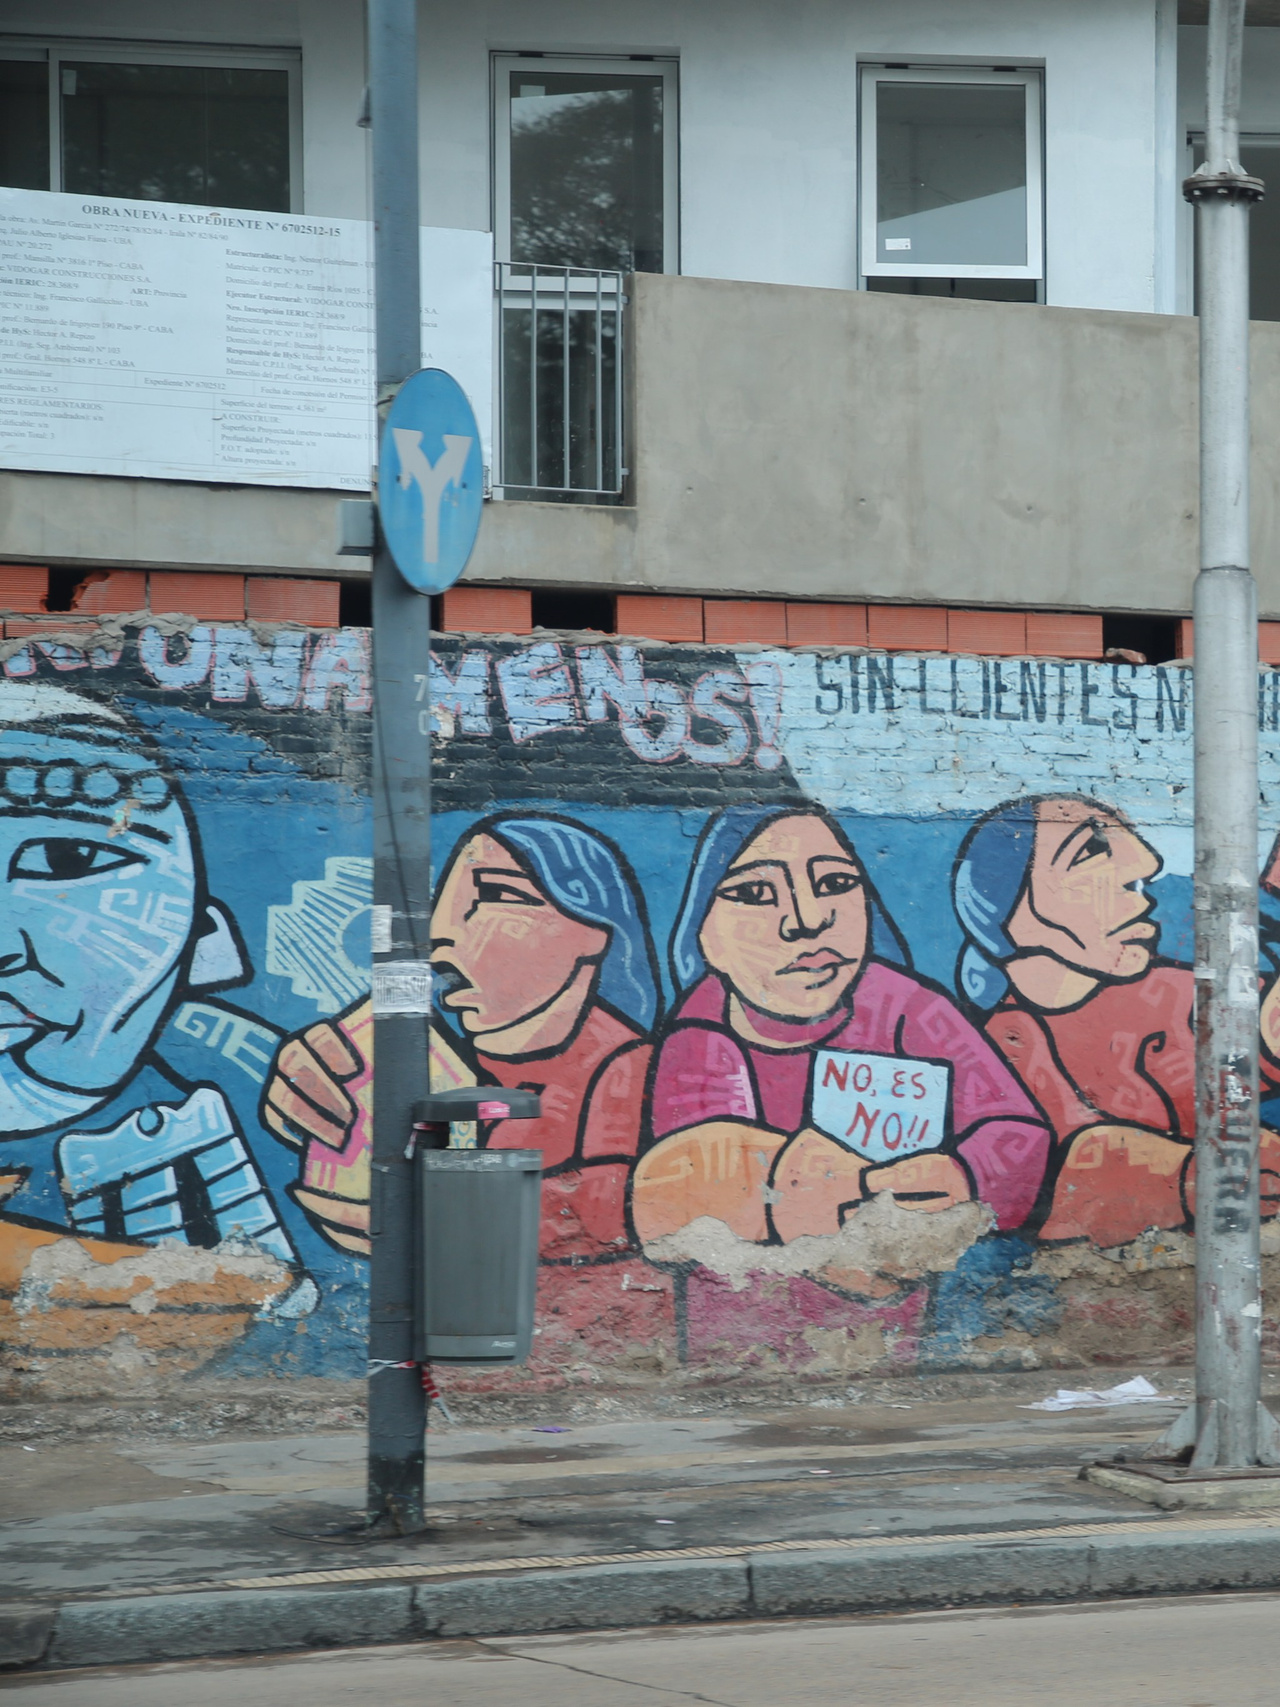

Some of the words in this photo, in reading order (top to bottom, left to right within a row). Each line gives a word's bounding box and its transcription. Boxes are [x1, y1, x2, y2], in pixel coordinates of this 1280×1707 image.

[82, 204, 120, 216] OBRA
[123, 208, 168, 220] NUEVA
[179, 213, 262, 229] EXPEDIENTE
[282, 222, 340, 236] 6702512-15
[138, 625, 374, 713] UNA
[815, 653, 895, 716] SIN
[1157, 665, 1187, 733] N
[891, 1071, 926, 1099] ES
[845, 1101, 930, 1151] NO!!
